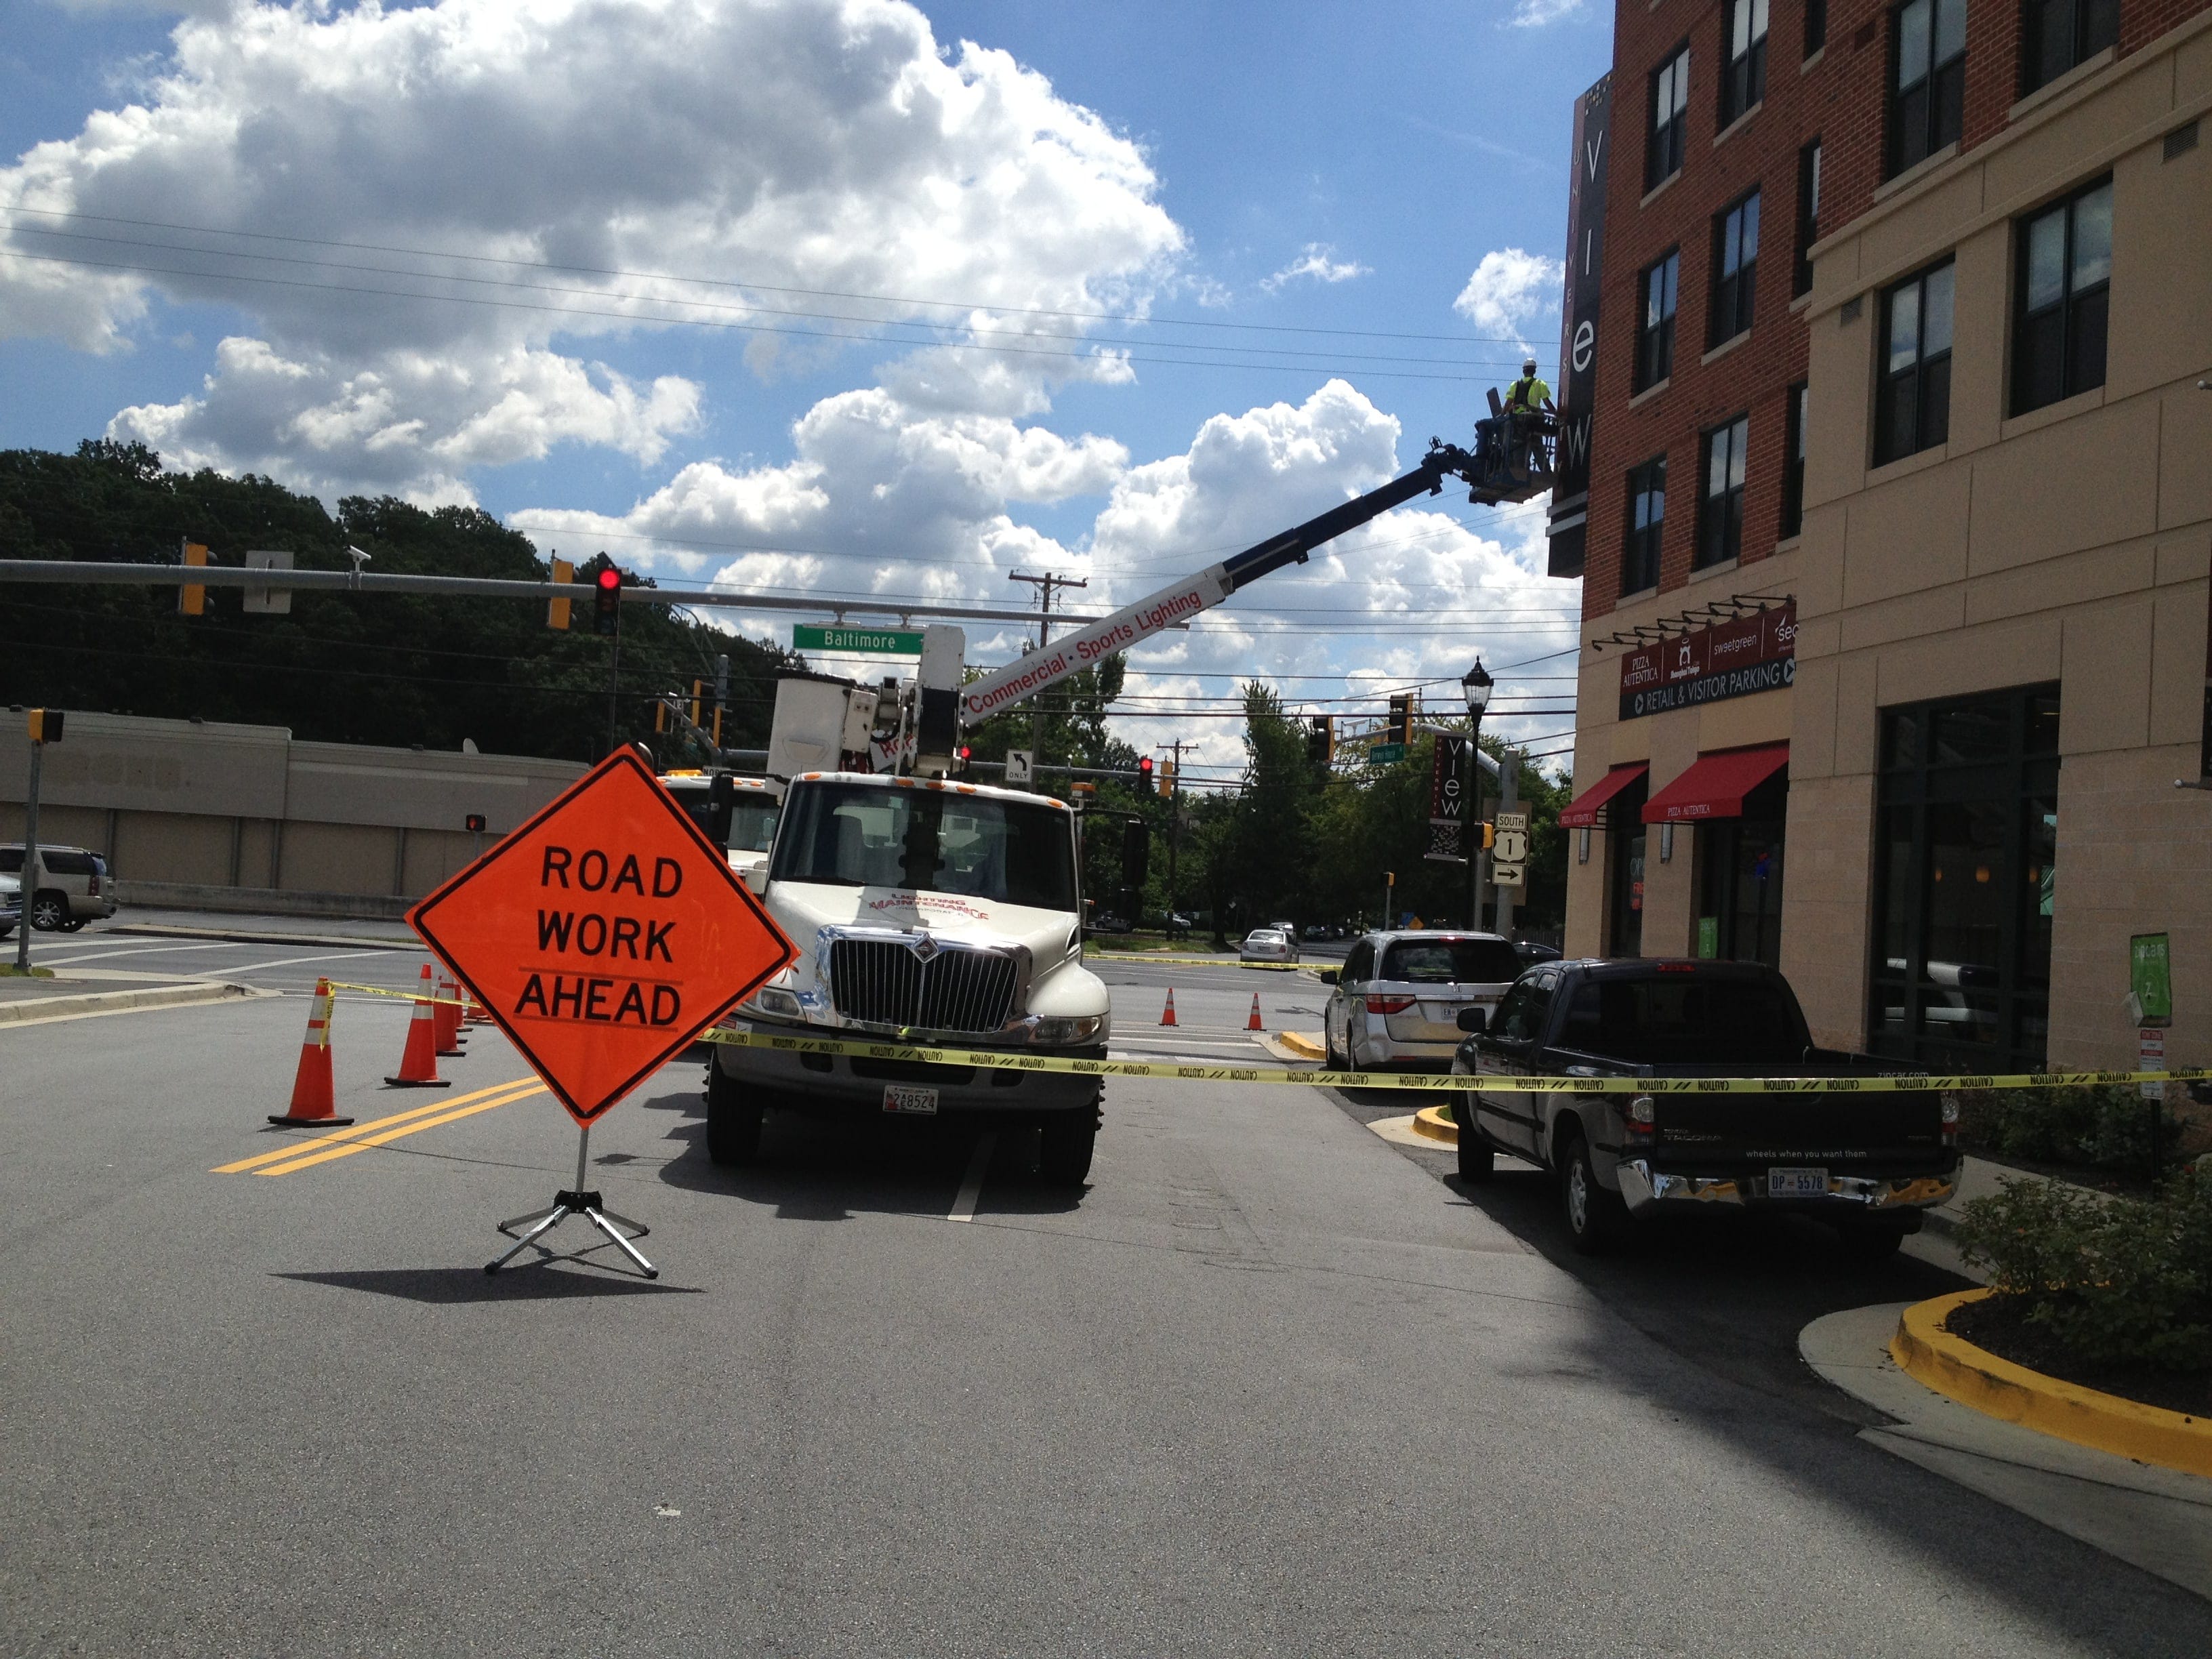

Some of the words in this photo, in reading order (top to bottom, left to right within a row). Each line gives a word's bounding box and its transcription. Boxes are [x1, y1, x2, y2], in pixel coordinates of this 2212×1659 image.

[824, 630, 895, 649] Baltimore
[1714, 634, 1757, 655] sweetgreen
[968, 653, 1068, 714] Commercial
[1076, 623, 1134, 661] Sports
[1136, 591, 1202, 632] Lighting
[1633, 655, 1650, 671] PIZZA
[1623, 668, 1658, 687] AUTENTICA
[1647, 689, 1675, 711] RETAIL
[1678, 688, 1685, 704] &
[1687, 675, 1726, 701] VISITOR
[1729, 663, 1780, 693] PARKING
[1498, 815, 1524, 827] SOUTH
[1507, 838, 1513, 855] 1
[541, 846, 682, 898] ROAD
[892, 893, 966, 905] LIGHTING
[869, 899, 989, 920] MAINTENANCE
[895, 906, 964, 916] INCORPORATD
[537, 909, 677, 963] WORK
[514, 973, 681, 1026] AHEAD
[918, 1050, 943, 1061] CAUTION
[970, 1054, 995, 1065] CAUTION
[1019, 1057, 1045, 1069] CAUTION
[1072, 1061, 1099, 1071] CAUTION
[1123, 1064, 1149, 1076] CAUTION
[1178, 1067, 1204, 1078] CAUTION
[1230, 1069, 1258, 1081] CAUTION
[1286, 1072, 1314, 1083] CAUTION
[1340, 1074, 1369, 1085] CAUTION
[1399, 1076, 1427, 1087] CAUTION
[1455, 1078, 1484, 1089] CAUTION
[1515, 1078, 1545, 1090] CAUTION
[1574, 1079, 1604, 1090] CAUTION
[1637, 1080, 1668, 1090] CAUTION
[1698, 1080, 1729, 1090] CAUTION
[1764, 1080, 1796, 1090] CAUTION
[1827, 1080, 1860, 1090] CAUTION
[1895, 1078, 1928, 1089] CAUTION
[1960, 1076, 1994, 1088] CAUTION
[2030, 1073, 2064, 1085] CAUTION
[2097, 1072, 2132, 1083] CAUTION
[2169, 1069, 2205, 1079] CAUTION
[1746, 1149, 1776, 1158] wheels
[1779, 1149, 1802, 1158] when
[1805, 1151, 1820, 1160] you
[1845, 1149, 1867, 1158] them
